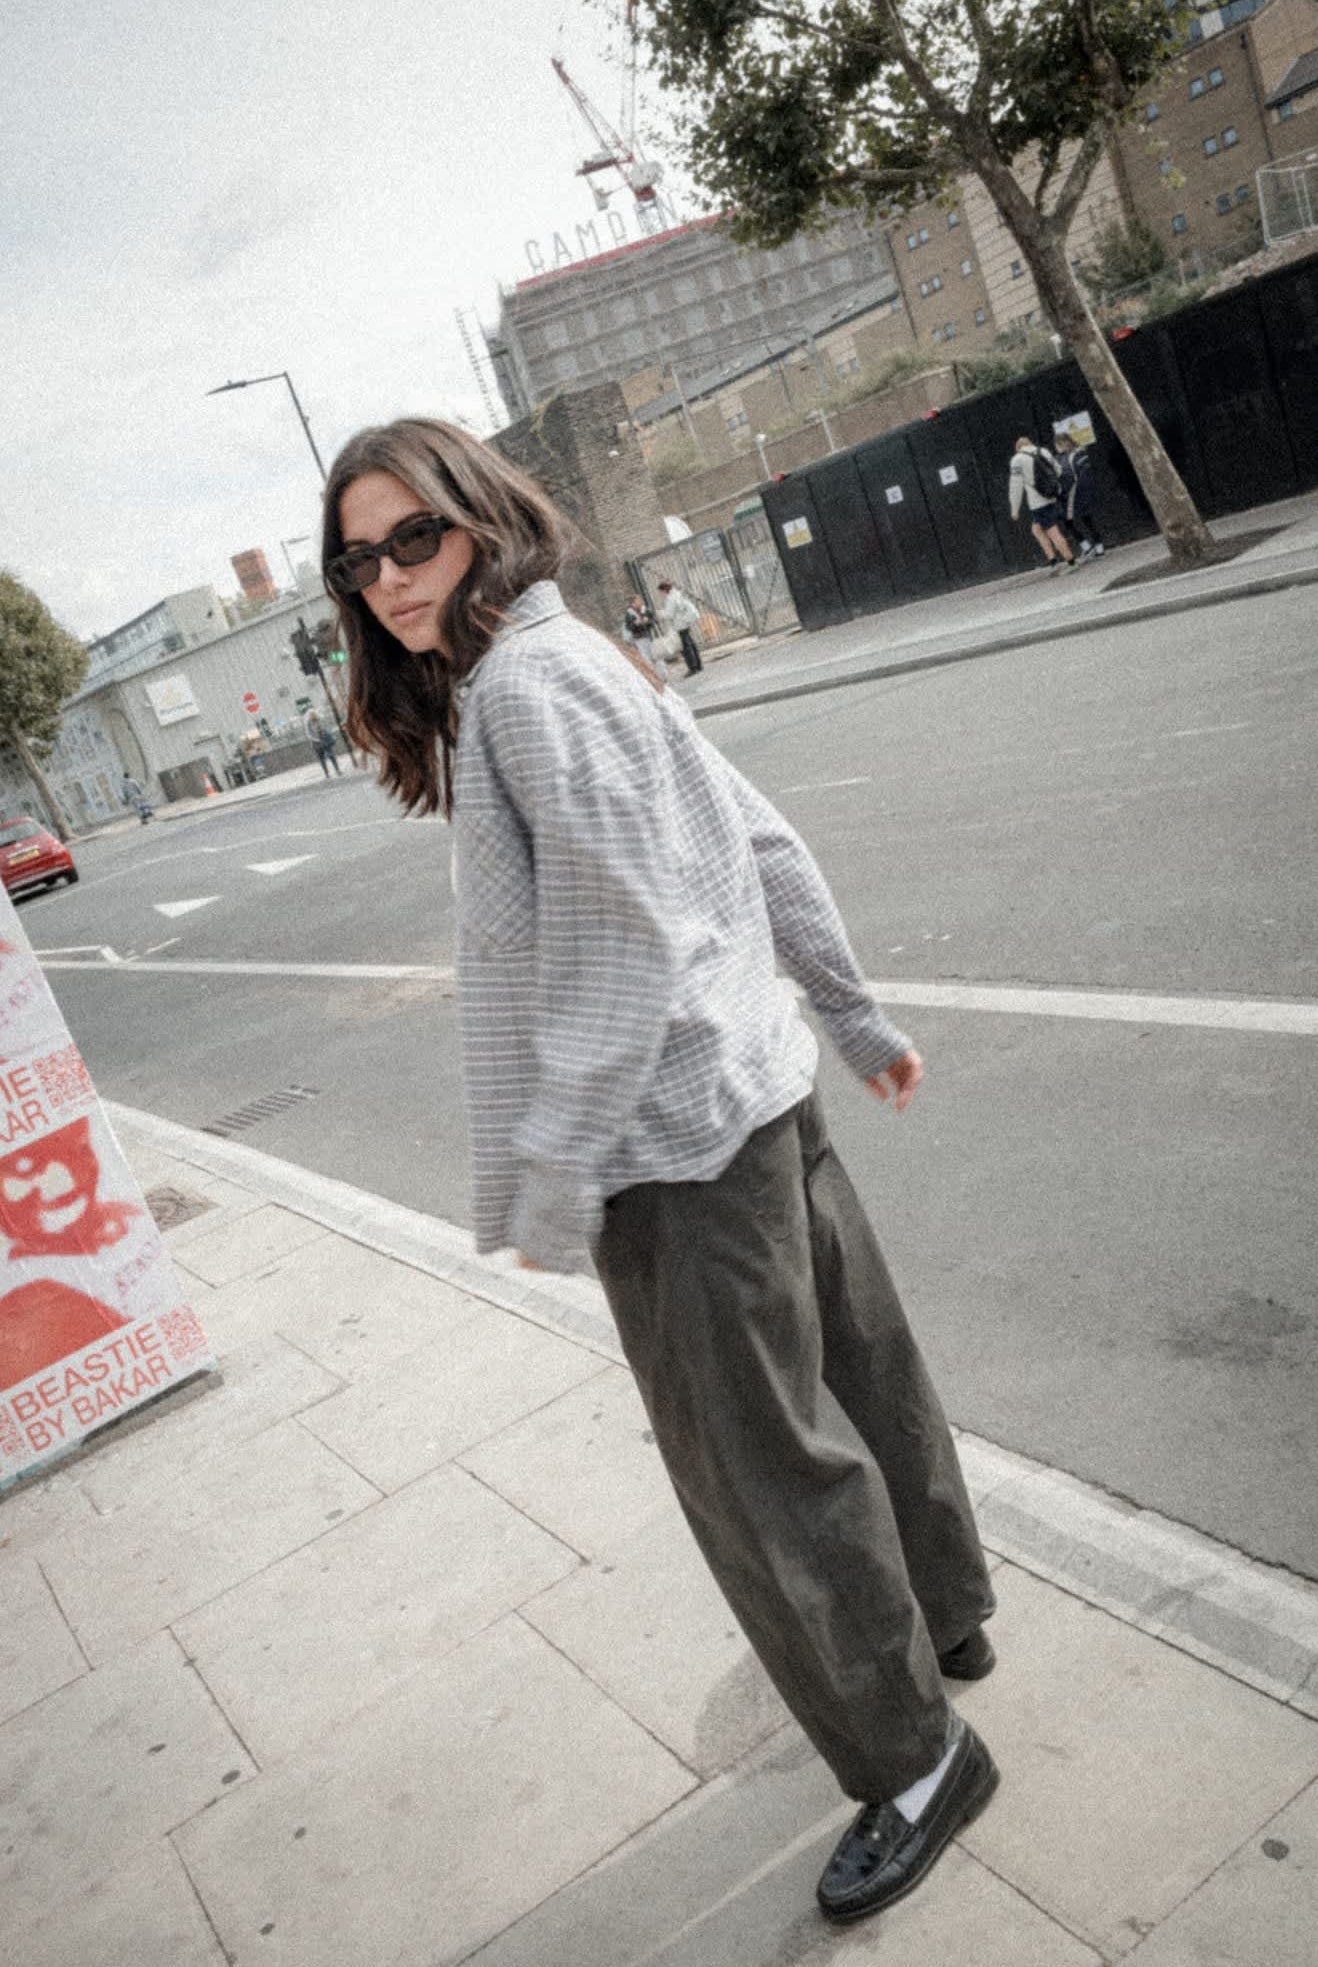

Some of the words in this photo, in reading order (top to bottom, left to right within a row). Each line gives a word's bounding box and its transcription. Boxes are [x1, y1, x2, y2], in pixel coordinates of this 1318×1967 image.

[11, 1322, 161, 1422] BEASTIE
[25, 1407, 65, 1451] BY
[71, 1353, 173, 1426] BAKAR
